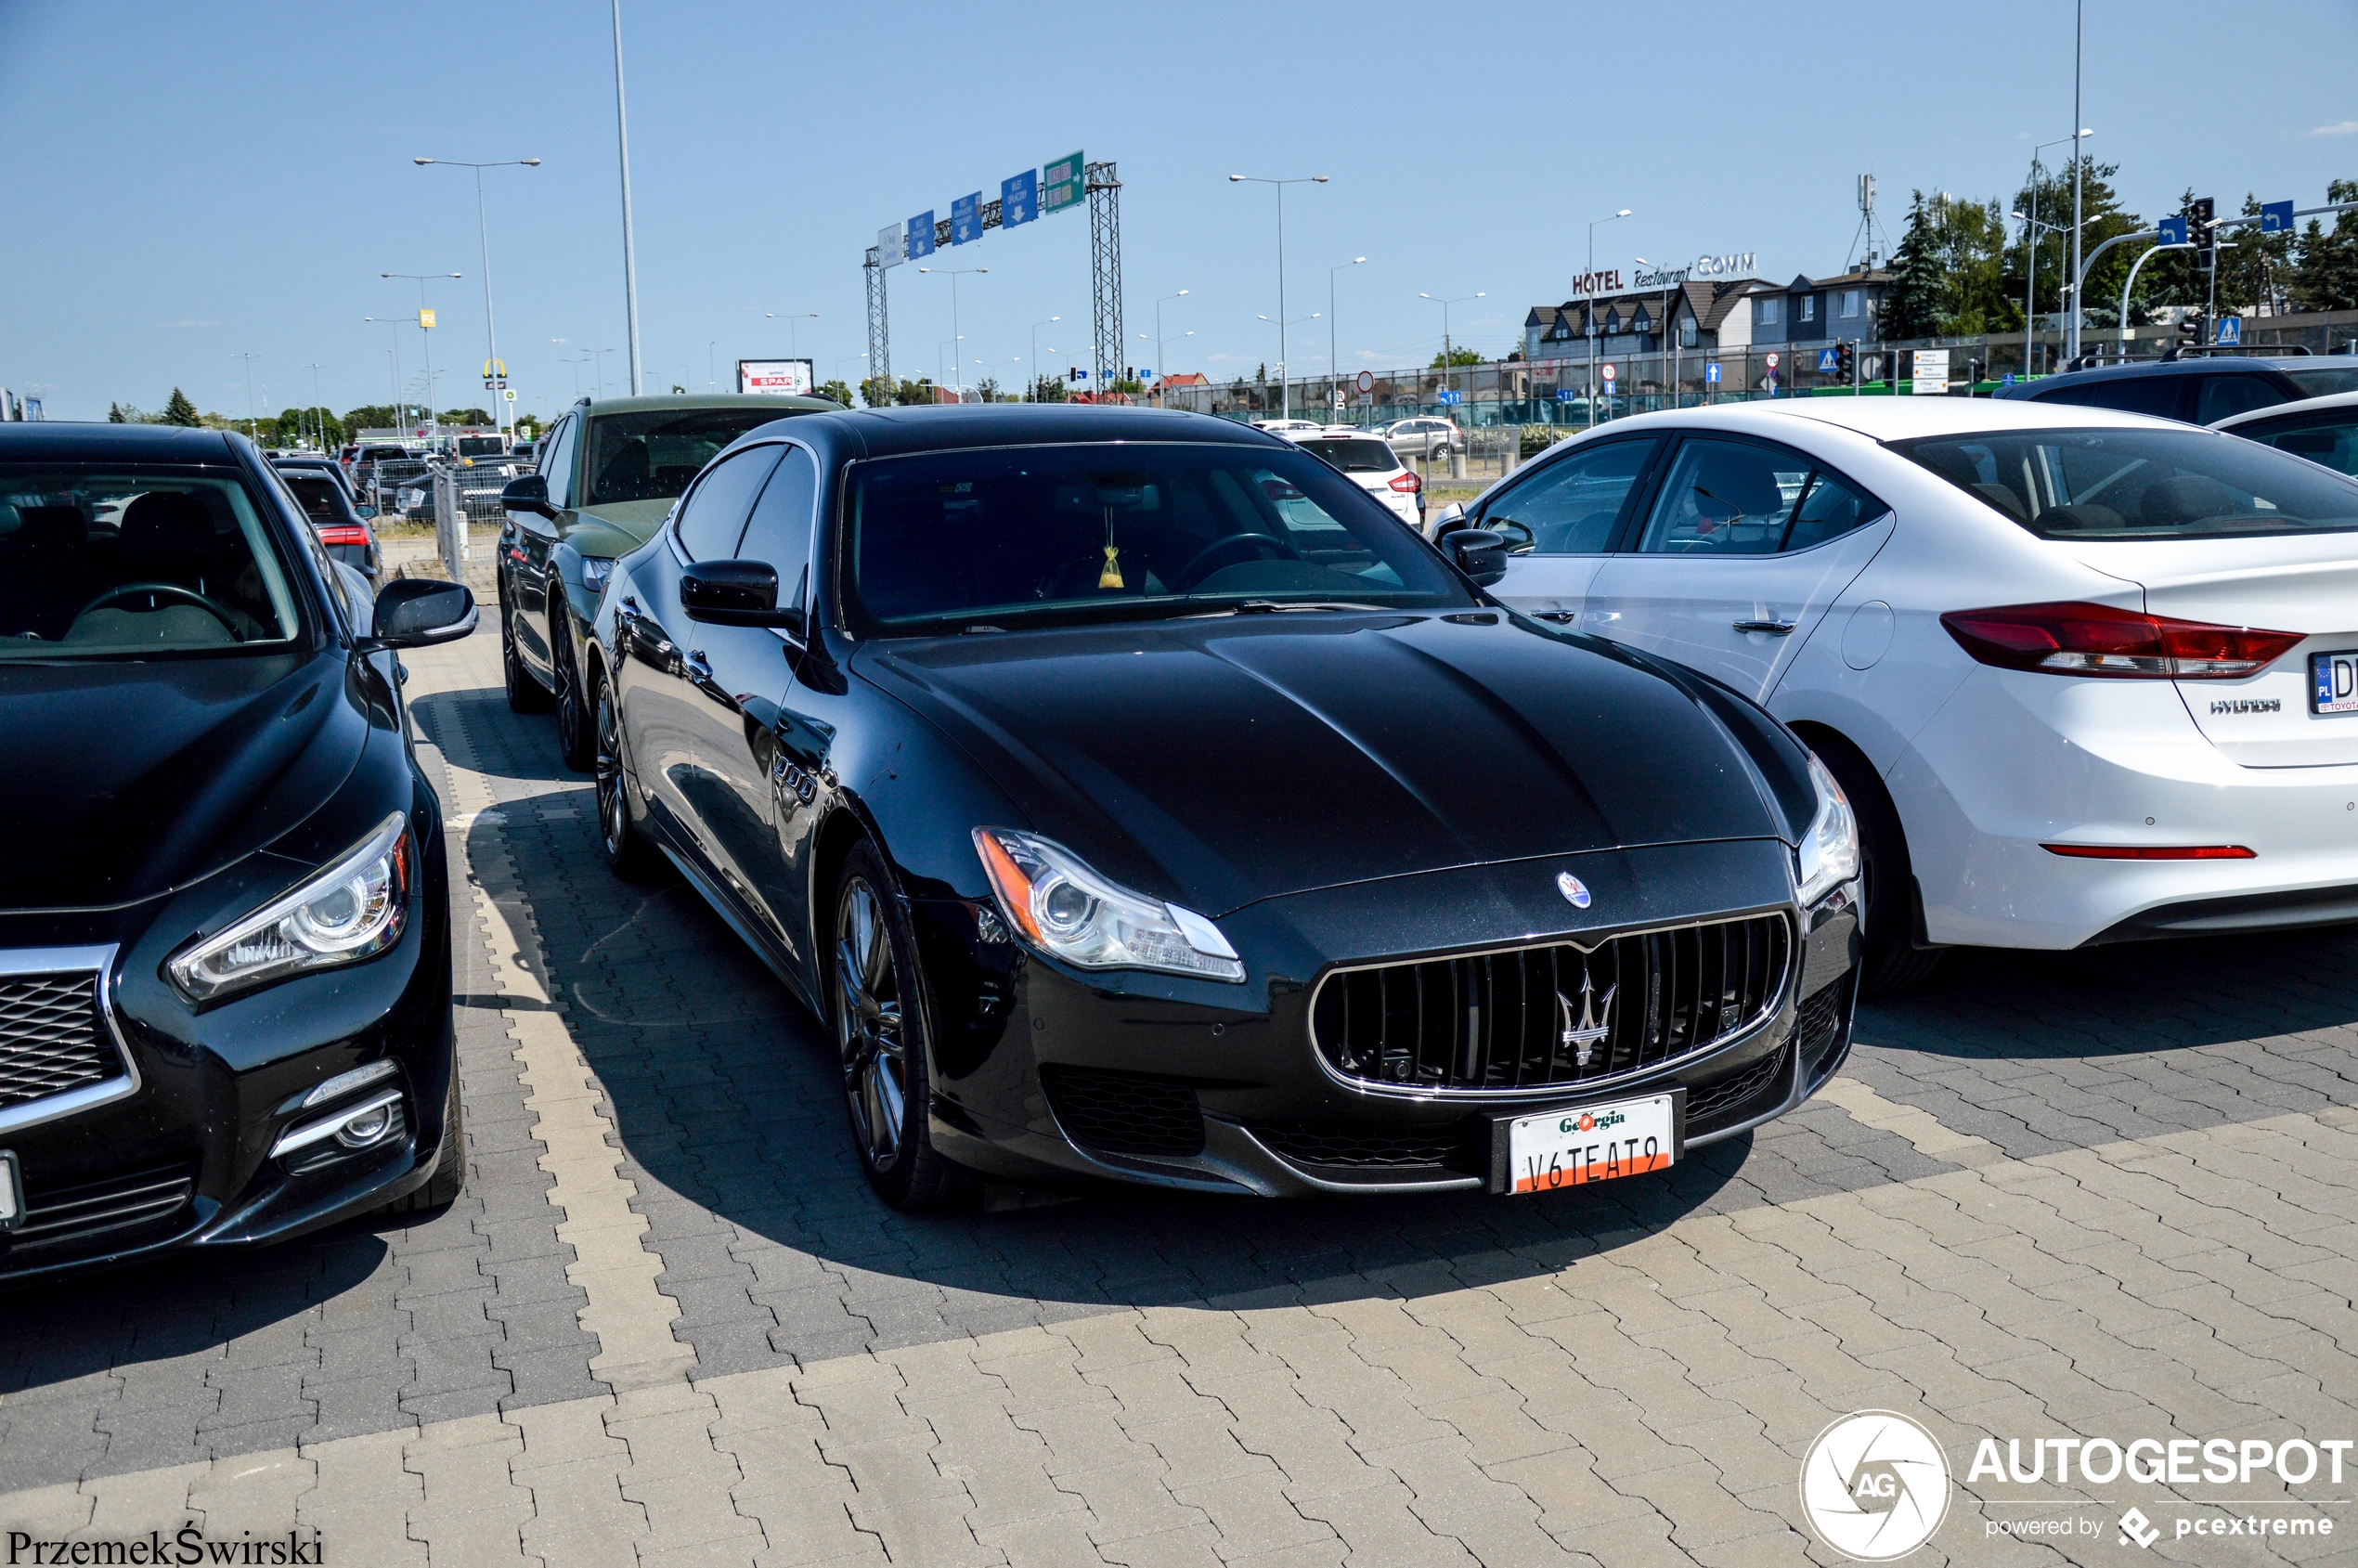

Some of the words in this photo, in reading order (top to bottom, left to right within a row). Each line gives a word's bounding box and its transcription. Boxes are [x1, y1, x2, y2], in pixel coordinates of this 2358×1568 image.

[1573, 269, 1624, 294] HOTEL
[1634, 263, 1693, 288] Restaurant
[422, 314, 434, 323] P2
[1768, 356, 1778, 364] 70
[1604, 367, 1614, 376] 70
[2334, 658, 2358, 698] D
[2318, 685, 2331, 697] PL
[2210, 698, 2281, 714] HYUNDAI
[2330, 701, 2358, 710] TOYOT
[1560, 1110, 1626, 1134] Georgia
[1528, 1135, 1658, 1191] V6TEAT9
